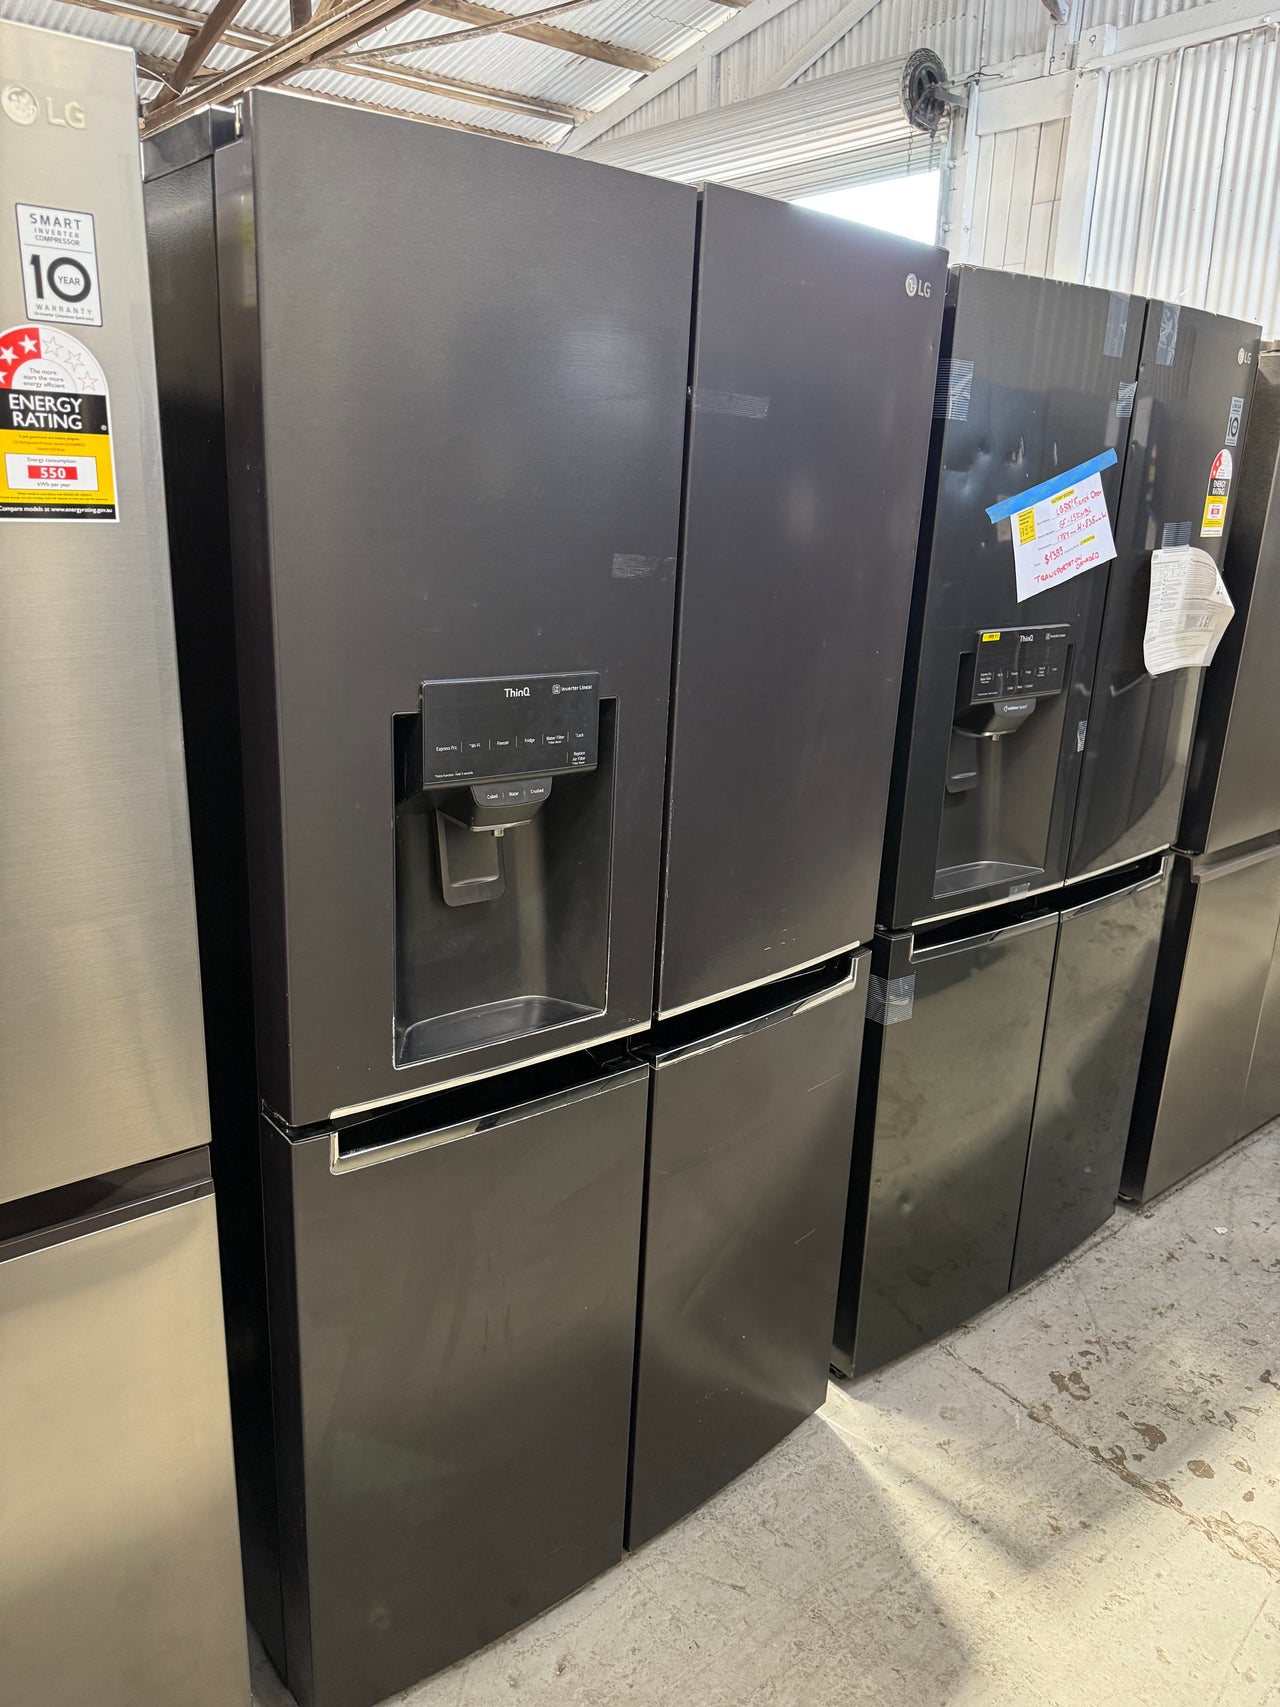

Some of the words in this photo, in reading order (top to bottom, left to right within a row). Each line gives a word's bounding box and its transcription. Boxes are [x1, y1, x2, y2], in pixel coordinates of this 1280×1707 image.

[46, 97, 87, 130] LG
[29, 213, 81, 230] SMART
[34, 227, 79, 238] INVERTER
[35, 235, 80, 246] COMPRESSOR
[30, 254, 91, 303] 10
[58, 275, 81, 286] YEAR
[918, 280, 931, 298] LG
[36, 303, 92, 315] WARRANTY
[1244, 352, 1252, 364] LG
[30, 367, 40, 375] The
[9, 393, 82, 413] ENERGY
[12, 411, 83, 430] RATING
[1228, 417, 1239, 437] 10
[40, 467, 66, 479] 550
[0, 505, 23, 513] Compare
[51, 506, 112, 514] www.energyrating.gov.au
[1045, 546, 1063, 566] $1399
[1076, 552, 1100, 569] DAMAGED
[1034, 555, 1082, 583] TRANSPORTATION
[1020, 634, 1033, 642] ThinQ
[504, 687, 531, 698] ThinQ
